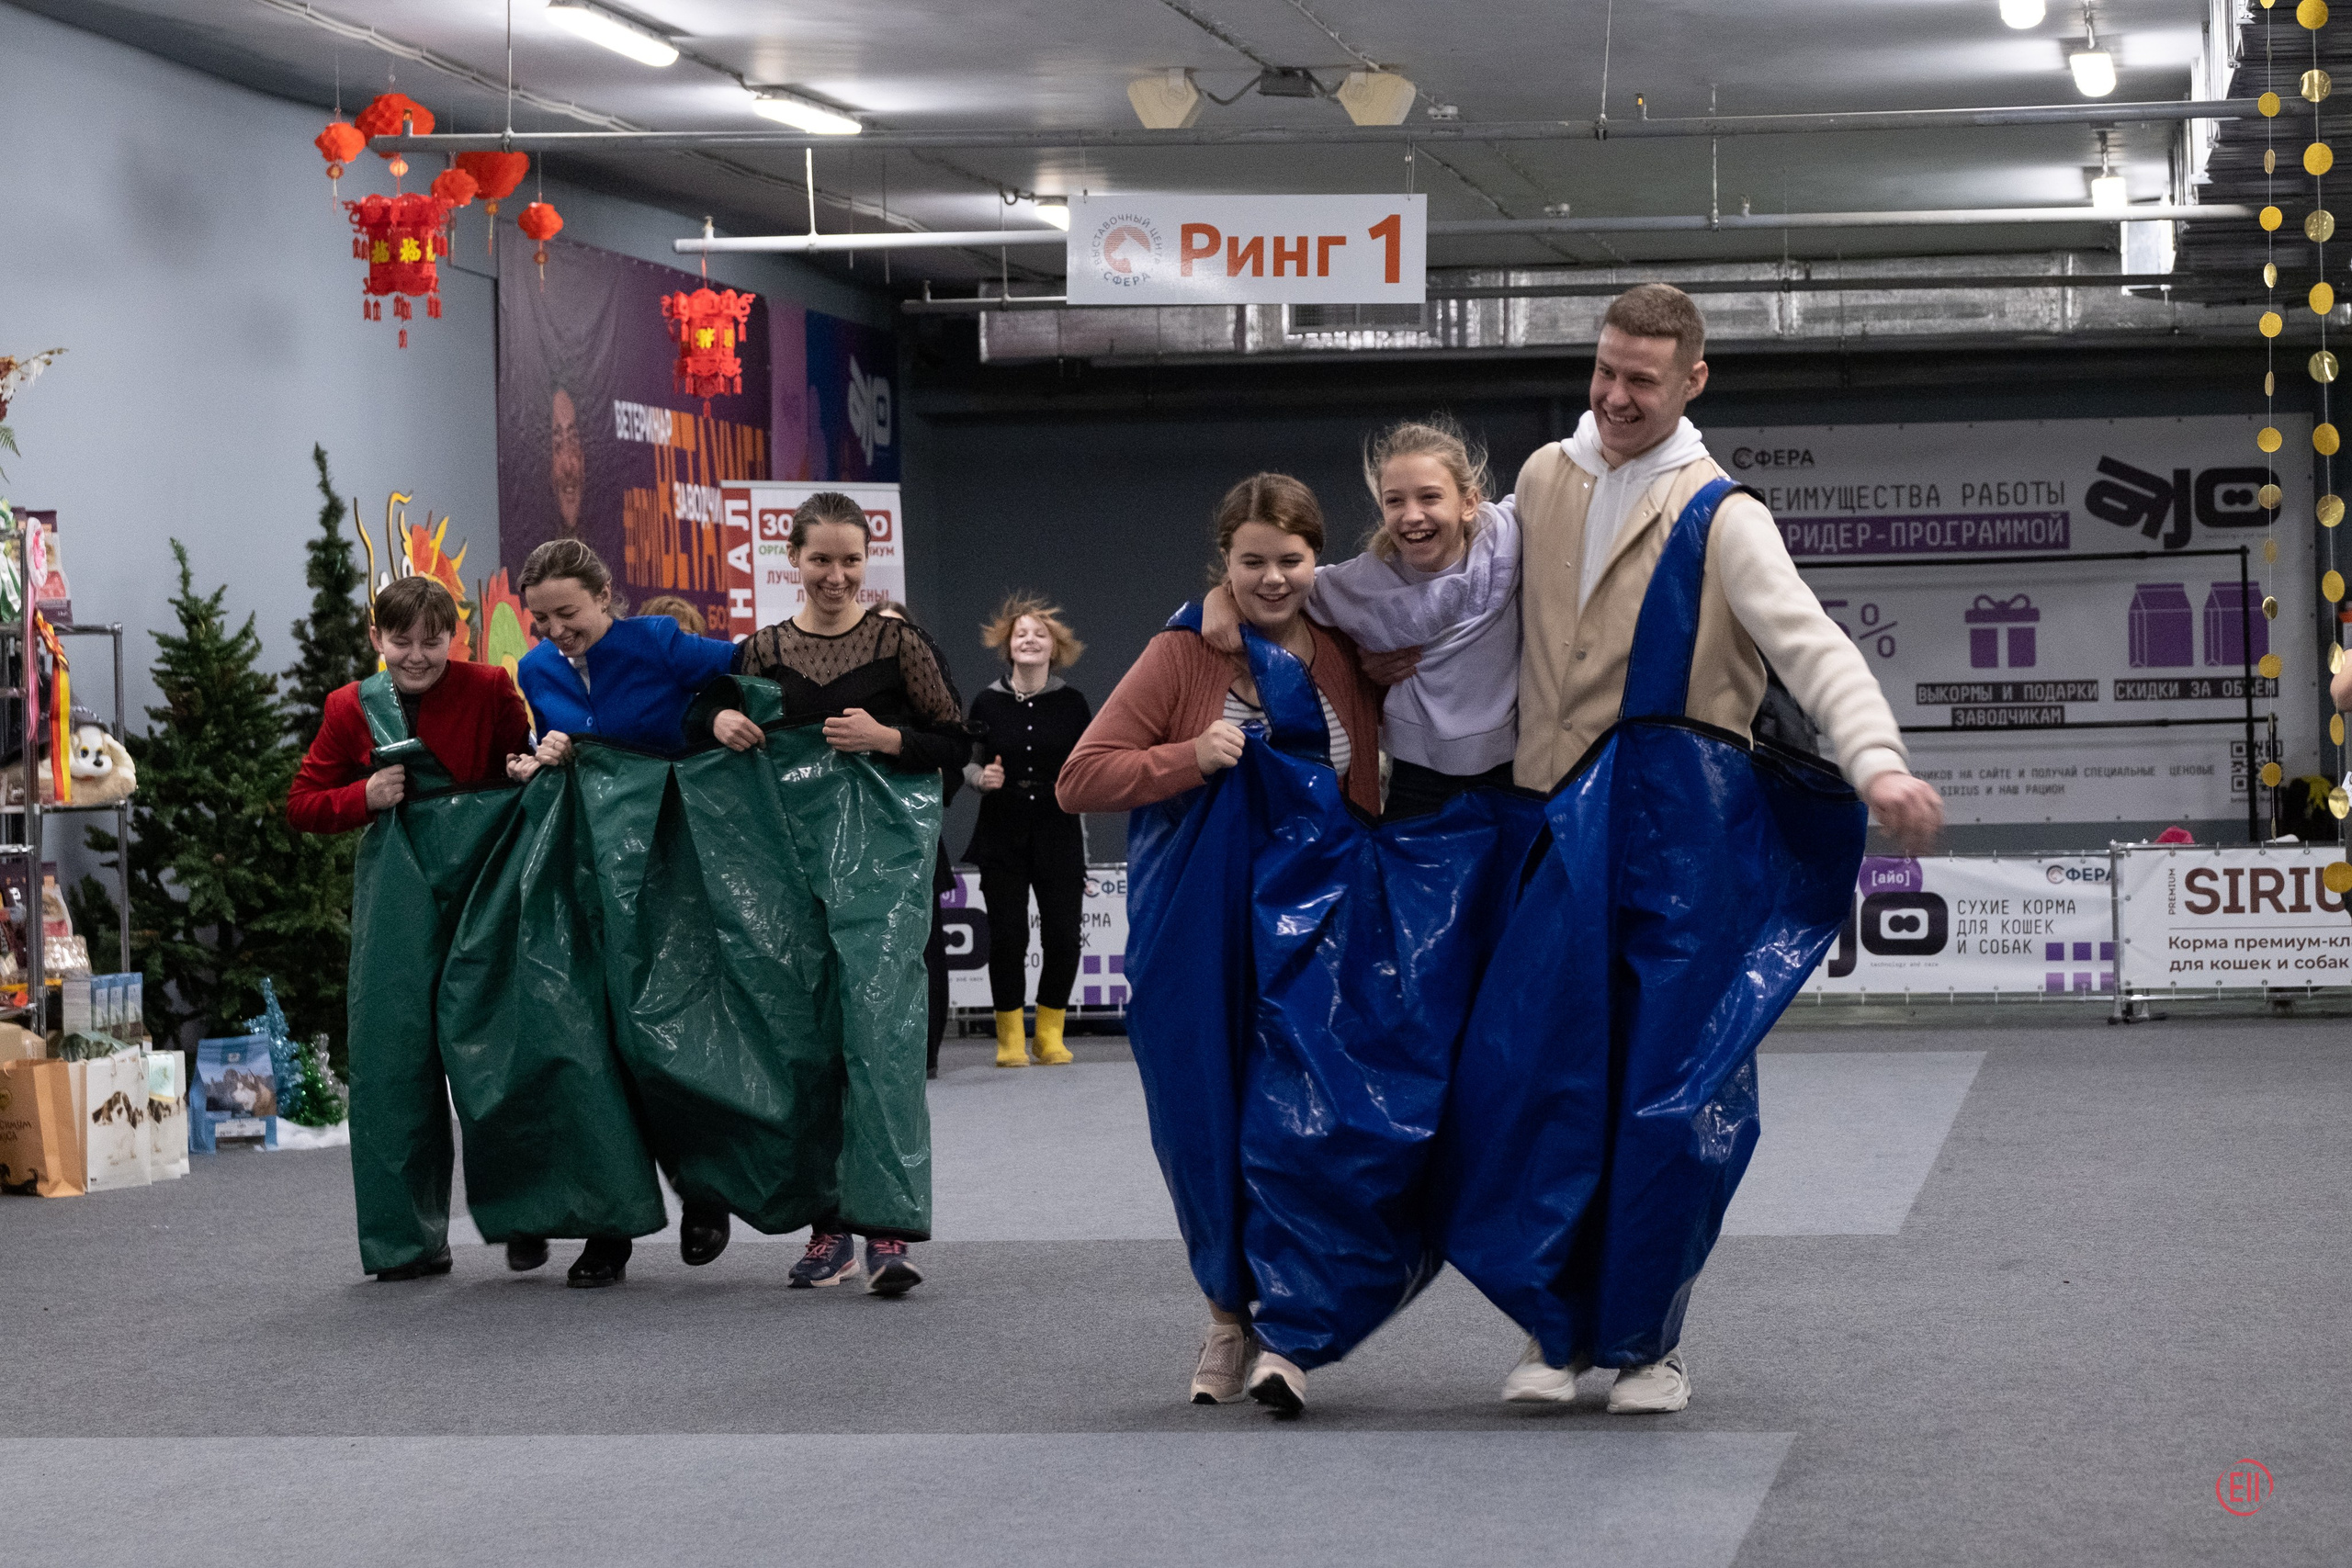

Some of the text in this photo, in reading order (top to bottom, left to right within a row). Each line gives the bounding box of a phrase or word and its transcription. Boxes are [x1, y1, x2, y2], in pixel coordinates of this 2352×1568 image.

[1092, 213, 1150, 265] ВЫСТАВОЧНЫЙ
[1181, 214, 1401, 283] Ринг 1
[1103, 271, 1151, 287] СФЕРА
[1732, 447, 1815, 469] СФЕРА
[1961, 480, 2065, 507] РАБОТЫ
[673, 480, 724, 529] ЗАВОДЧИ
[1779, 513, 2064, 552] РИДЕР-ПРОГРАММОЙ
[1918, 682, 2098, 703] ВЫКОРМЫ И ПОДАРКИ
[2115, 682, 2179, 701] СКИДКИ
[2190, 681, 2211, 698] ЗА
[1954, 707, 2062, 727] ЗАВОДЧИКАМ
[1959, 769, 1973, 779] НА
[1979, 766, 2012, 780] САЙТЕ
[2031, 764, 2078, 779] ПОЛУЧАЙ
[2084, 765, 2156, 779] СПЕЦИАЛЬНЫЕ
[1084, 877, 1126, 898] СФЕ
[1871, 870, 1910, 886] [айо]
[2184, 866, 2348, 915] SIRIU
[1957, 899, 2076, 915] СУХИЕ КОРМА
[1082, 912, 1112, 928] РМА
[1956, 919, 2054, 937] ДЛЯ КОШЕК
[1957, 939, 2032, 953] И СОБАК
[2169, 936, 2352, 952] Корма премиум-кл
[2169, 954, 2349, 973] для кошек и собак
